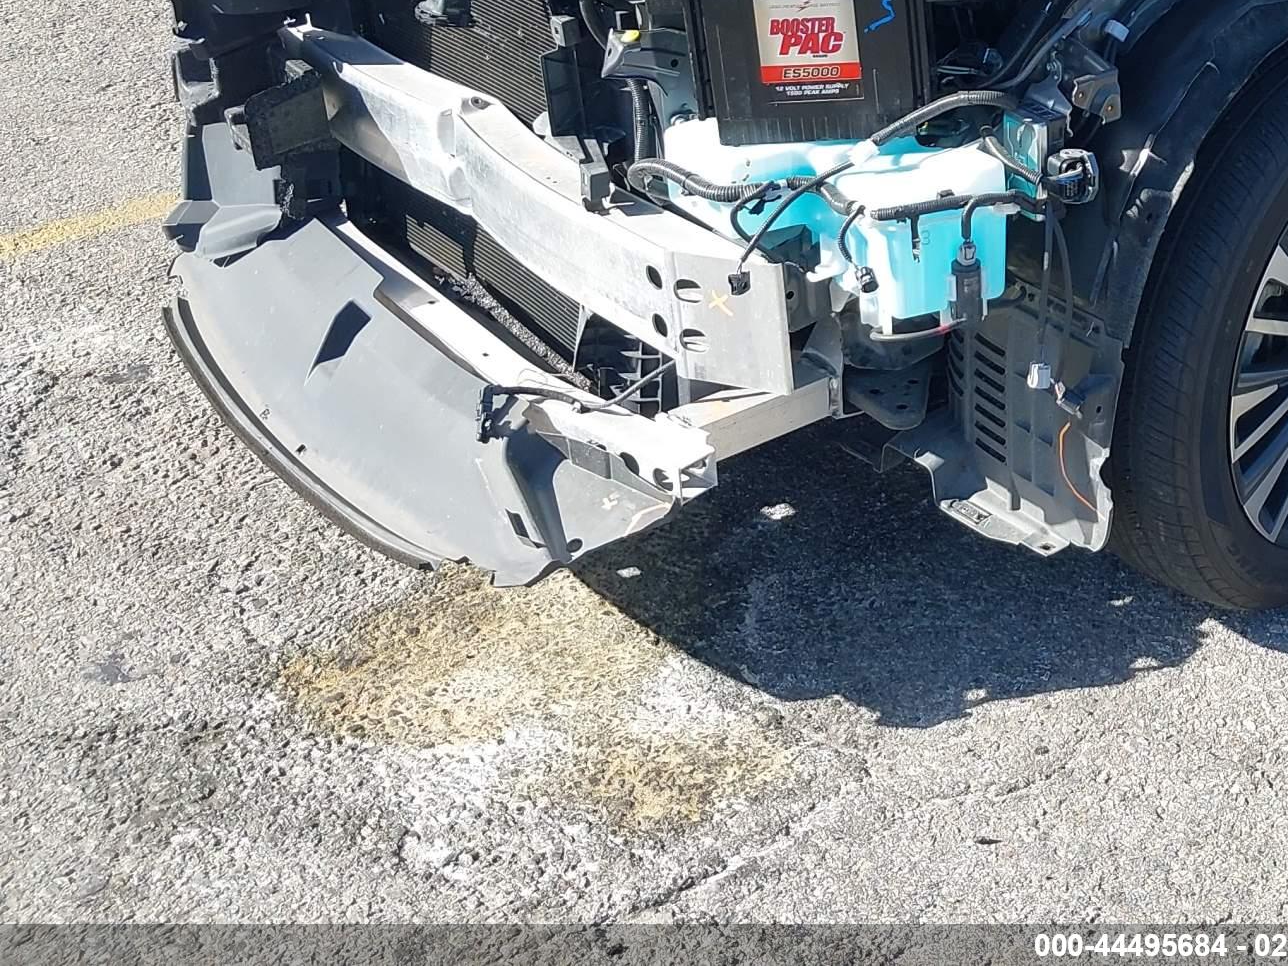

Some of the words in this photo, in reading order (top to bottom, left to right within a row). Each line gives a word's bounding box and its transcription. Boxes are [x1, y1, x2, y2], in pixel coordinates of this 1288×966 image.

[770, 16, 836, 35] BOOSTER
[778, 32, 844, 56] PAC
[783, 66, 840, 79] ES5000
